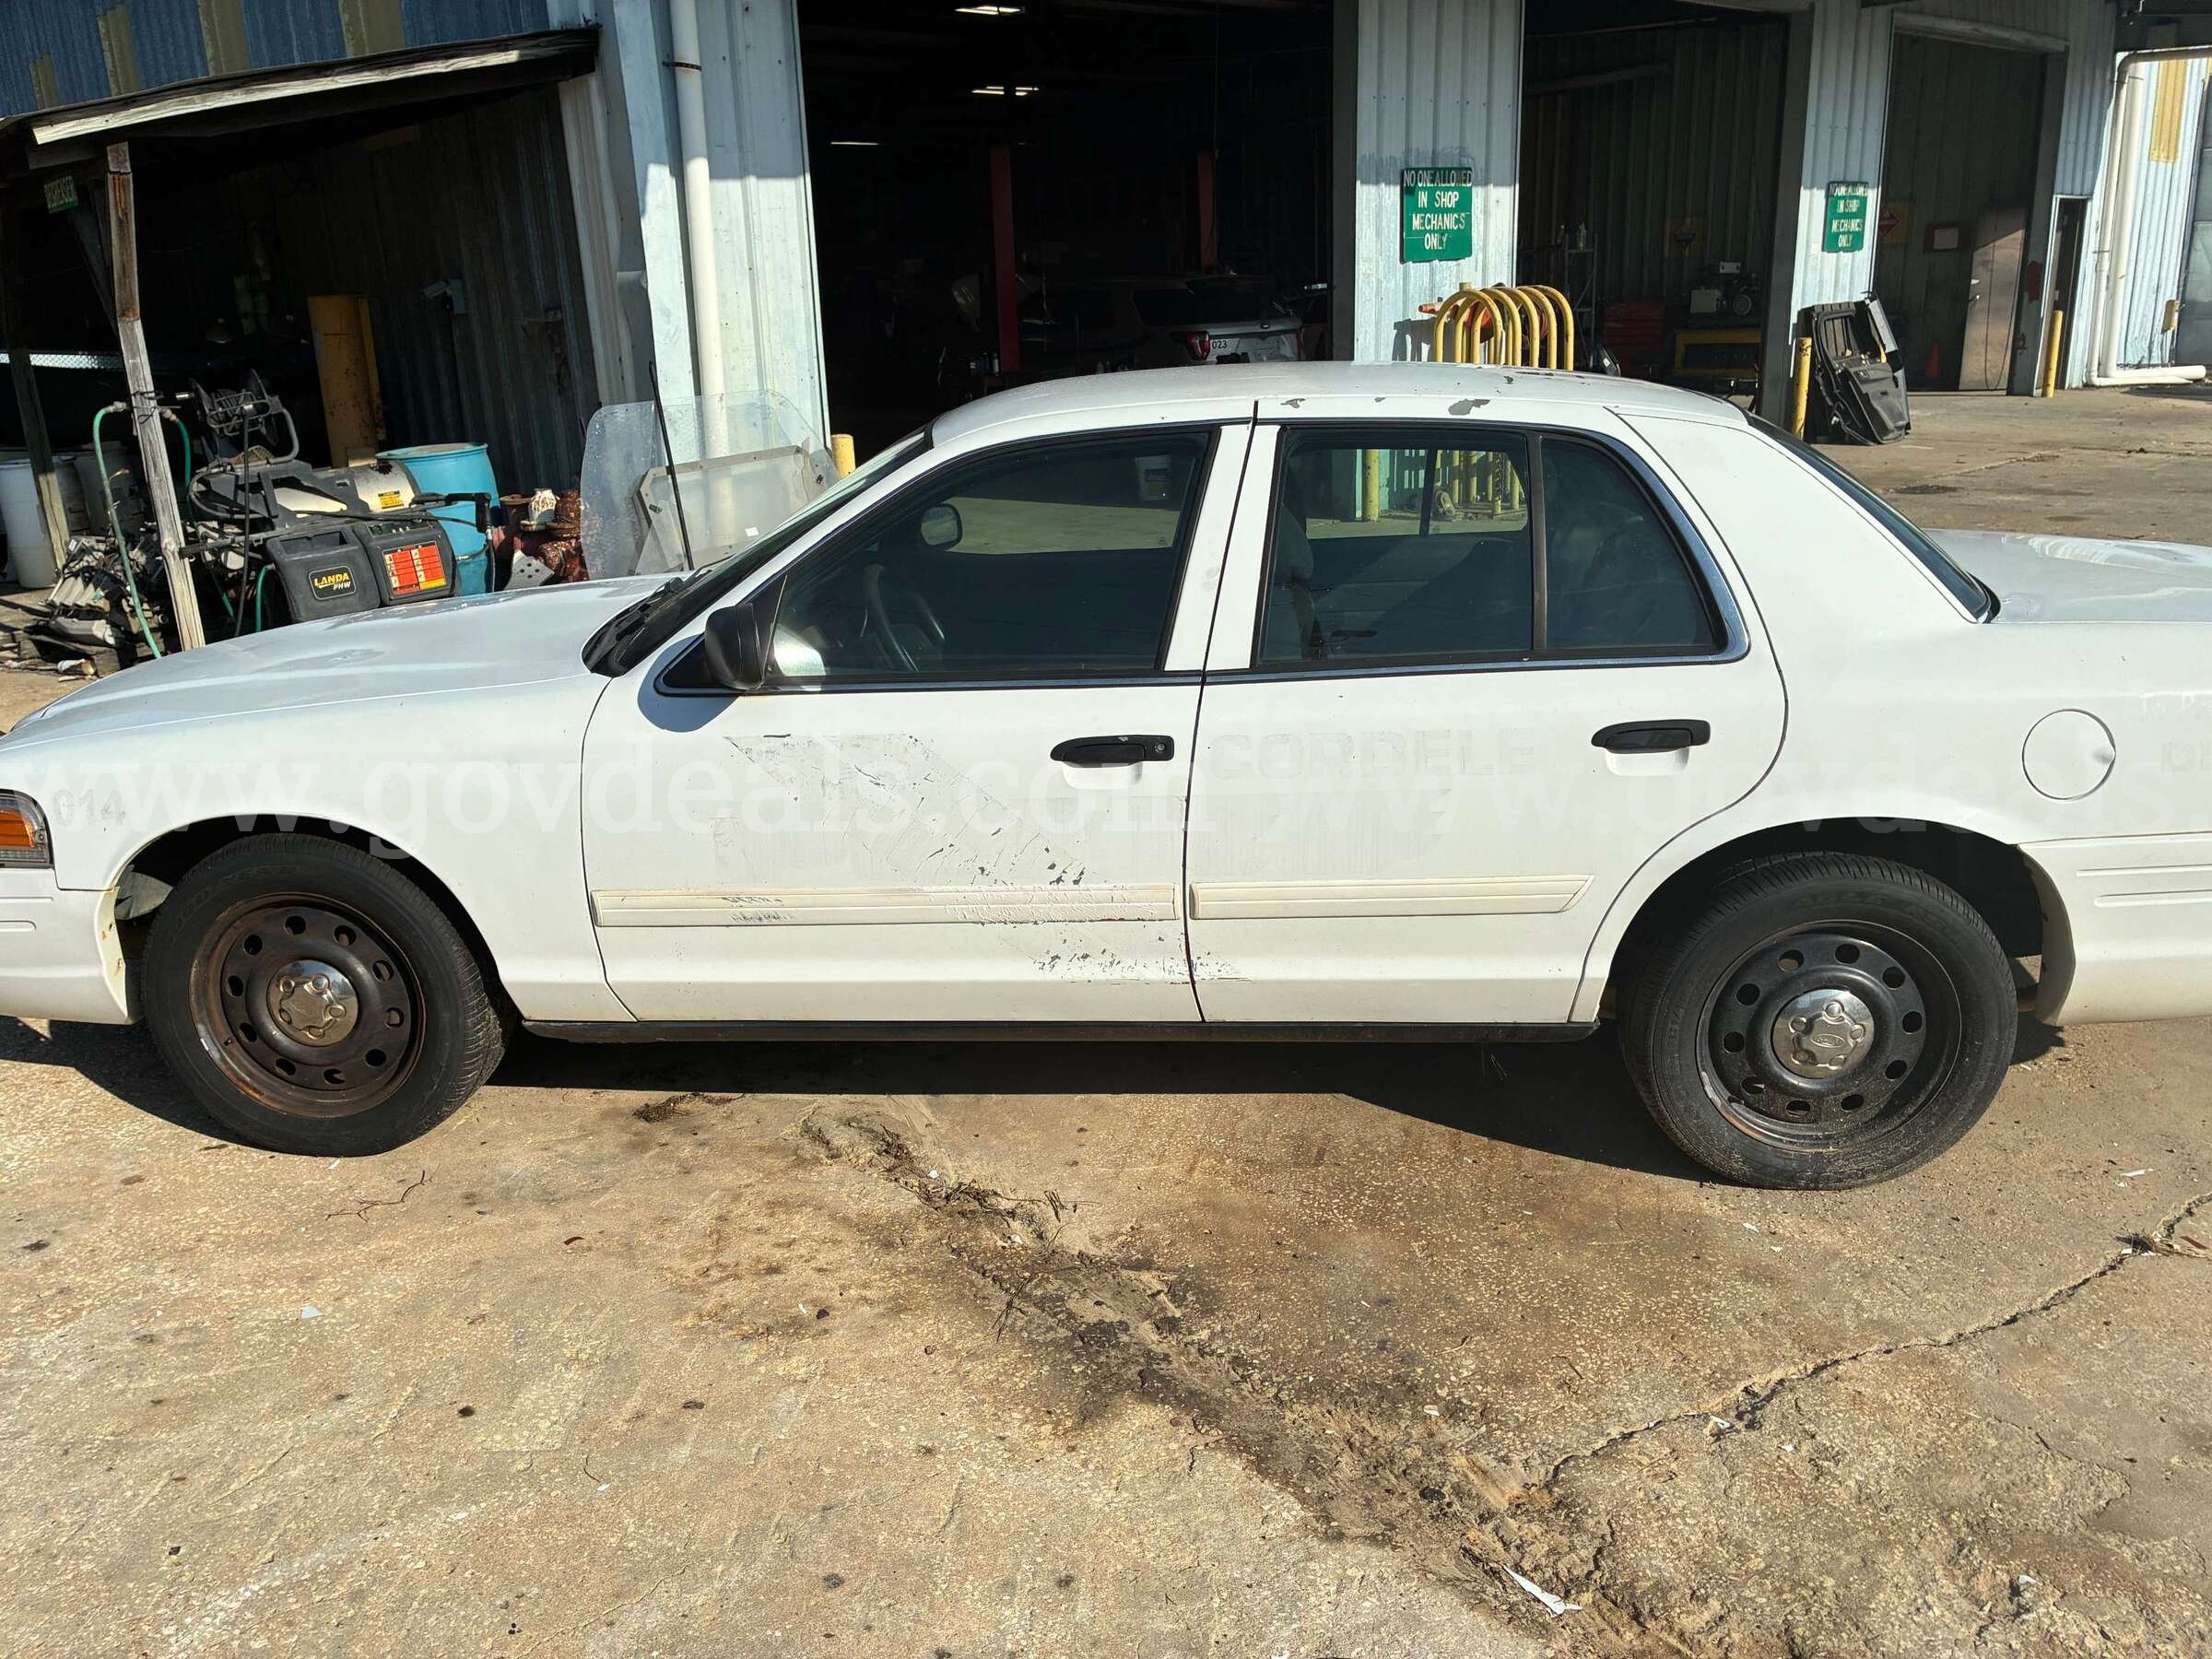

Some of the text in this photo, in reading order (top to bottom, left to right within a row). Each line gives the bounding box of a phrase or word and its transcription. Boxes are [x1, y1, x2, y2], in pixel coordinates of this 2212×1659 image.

[1404, 170, 1473, 187] NO ONE ALLOWED
[1418, 190, 1459, 208] IN SHOP
[1837, 198, 1860, 213] IN SHOP
[1412, 212, 1465, 230] MECHANICS
[1831, 218, 1863, 233] MECHANICS
[1424, 233, 1448, 251] ONLY
[1838, 233, 1853, 248] ONLY
[1211, 340, 1228, 349] 023
[313, 572, 350, 586] LANDA
[333, 582, 351, 591] PHW
